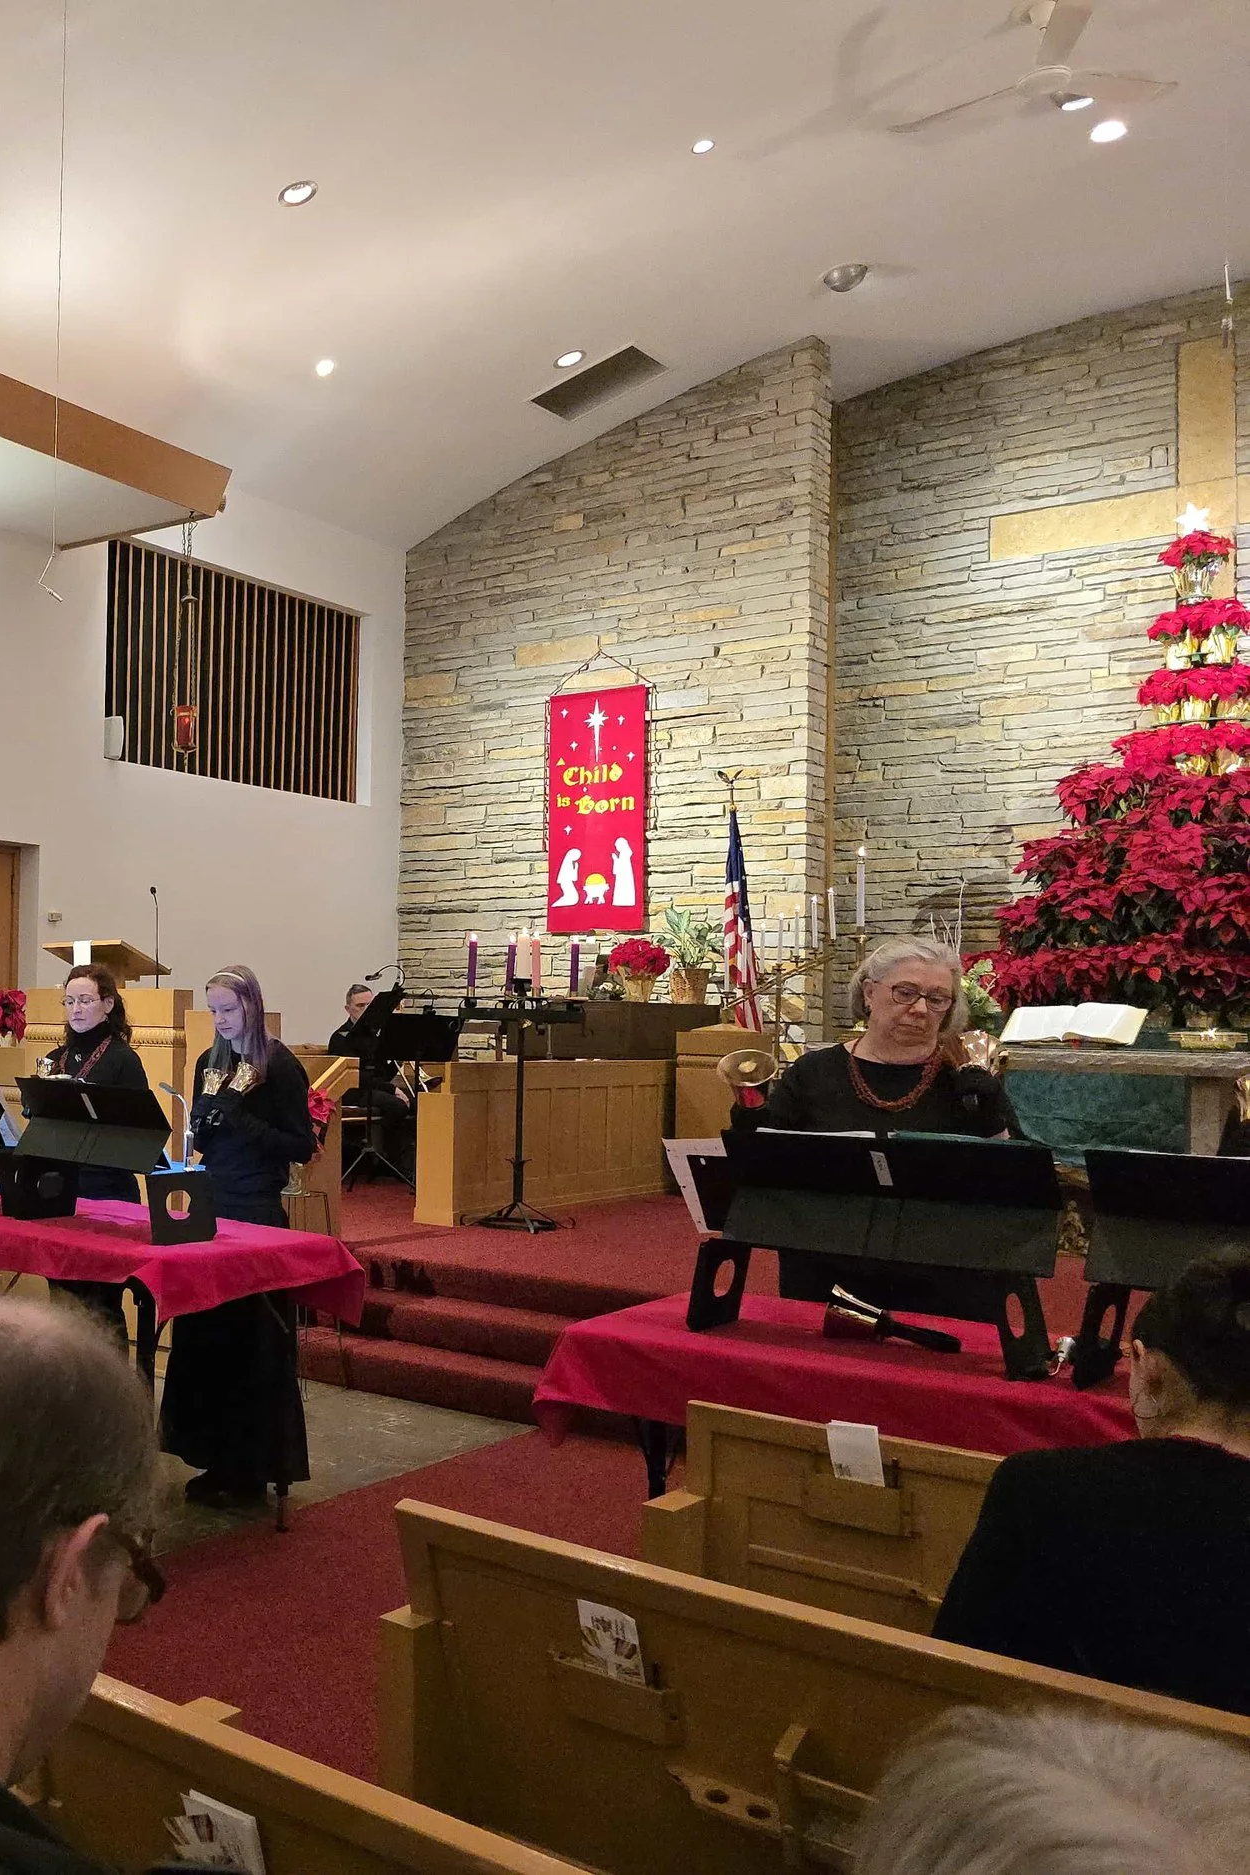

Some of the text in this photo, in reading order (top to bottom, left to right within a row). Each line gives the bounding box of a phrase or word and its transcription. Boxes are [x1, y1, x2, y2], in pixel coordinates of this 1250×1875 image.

[563, 762, 623, 786] Child
[556, 793, 635, 815] is Born
